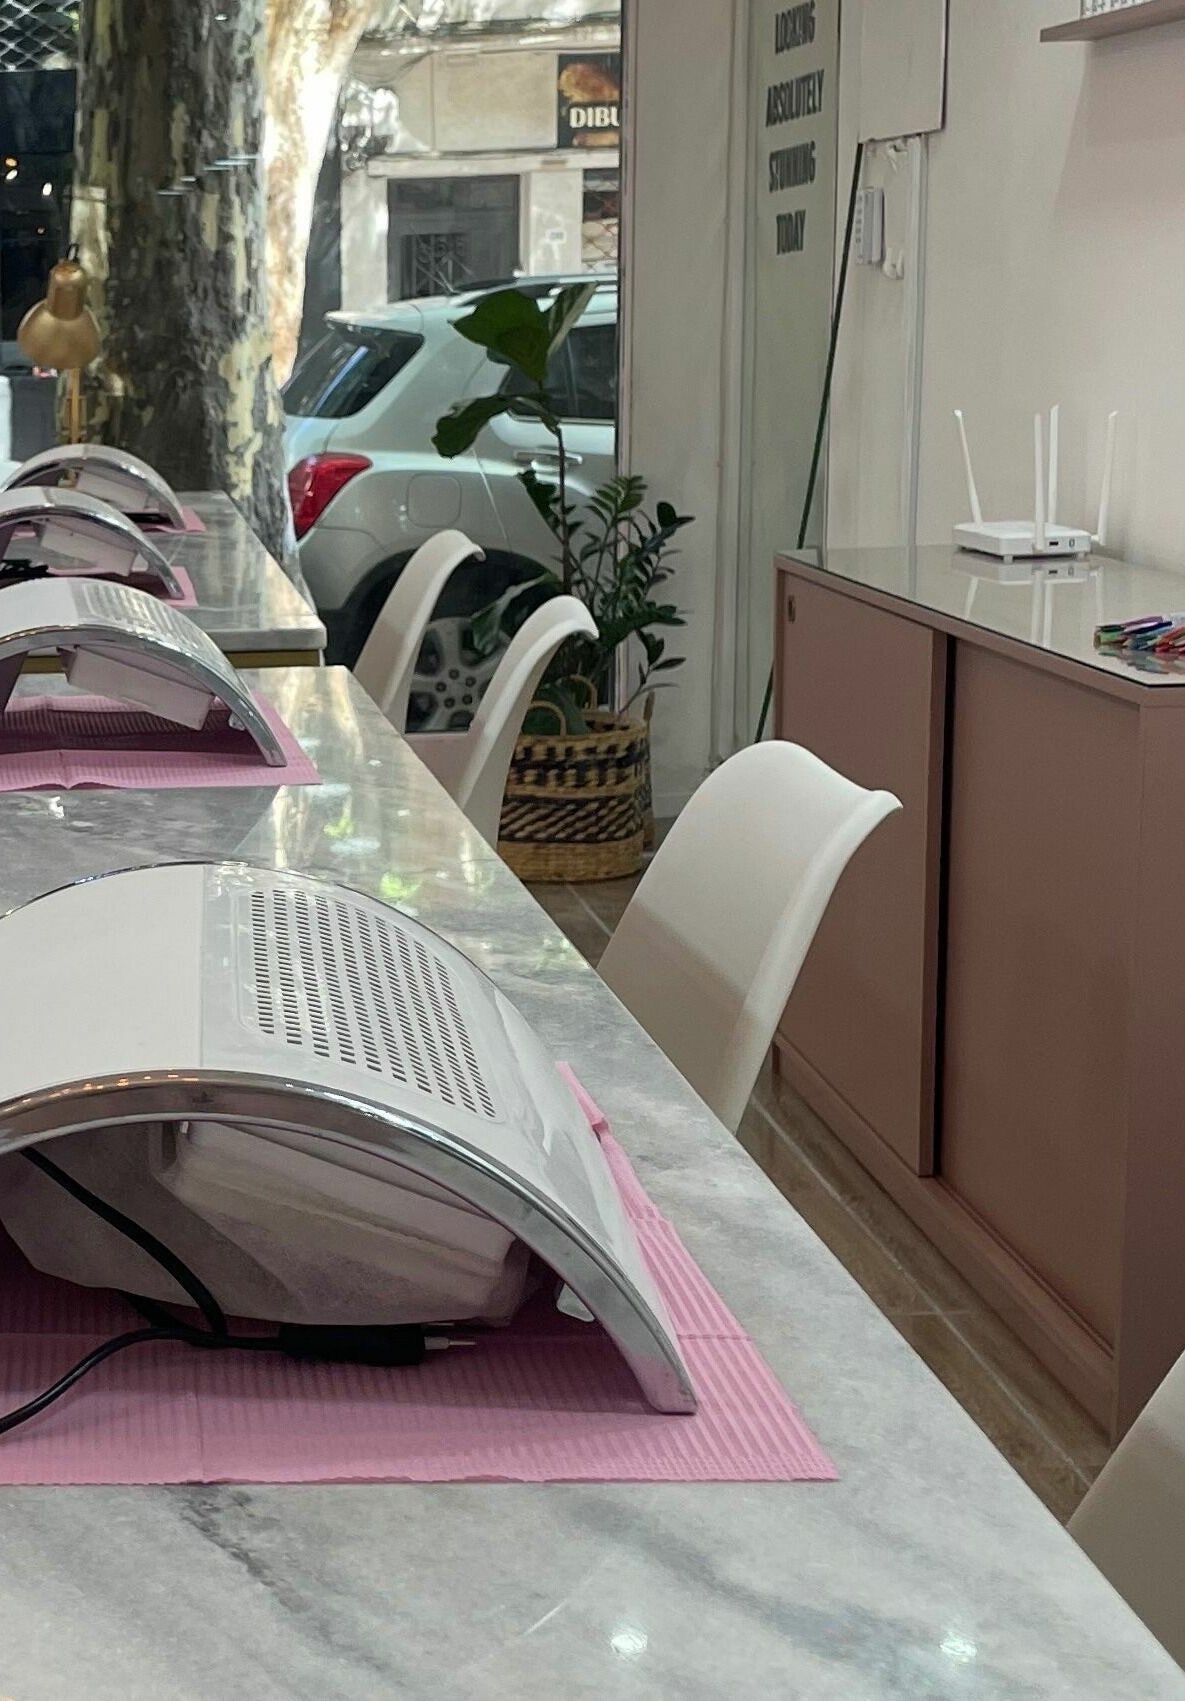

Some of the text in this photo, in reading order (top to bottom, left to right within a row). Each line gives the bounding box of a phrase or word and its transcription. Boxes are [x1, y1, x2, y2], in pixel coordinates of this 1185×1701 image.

[775, 0, 815, 54] LOOKING
[766, 69, 824, 127] ABSOLUTELY
[769, 140, 815, 193] STUNNING
[776, 208, 806, 255] TODAY
